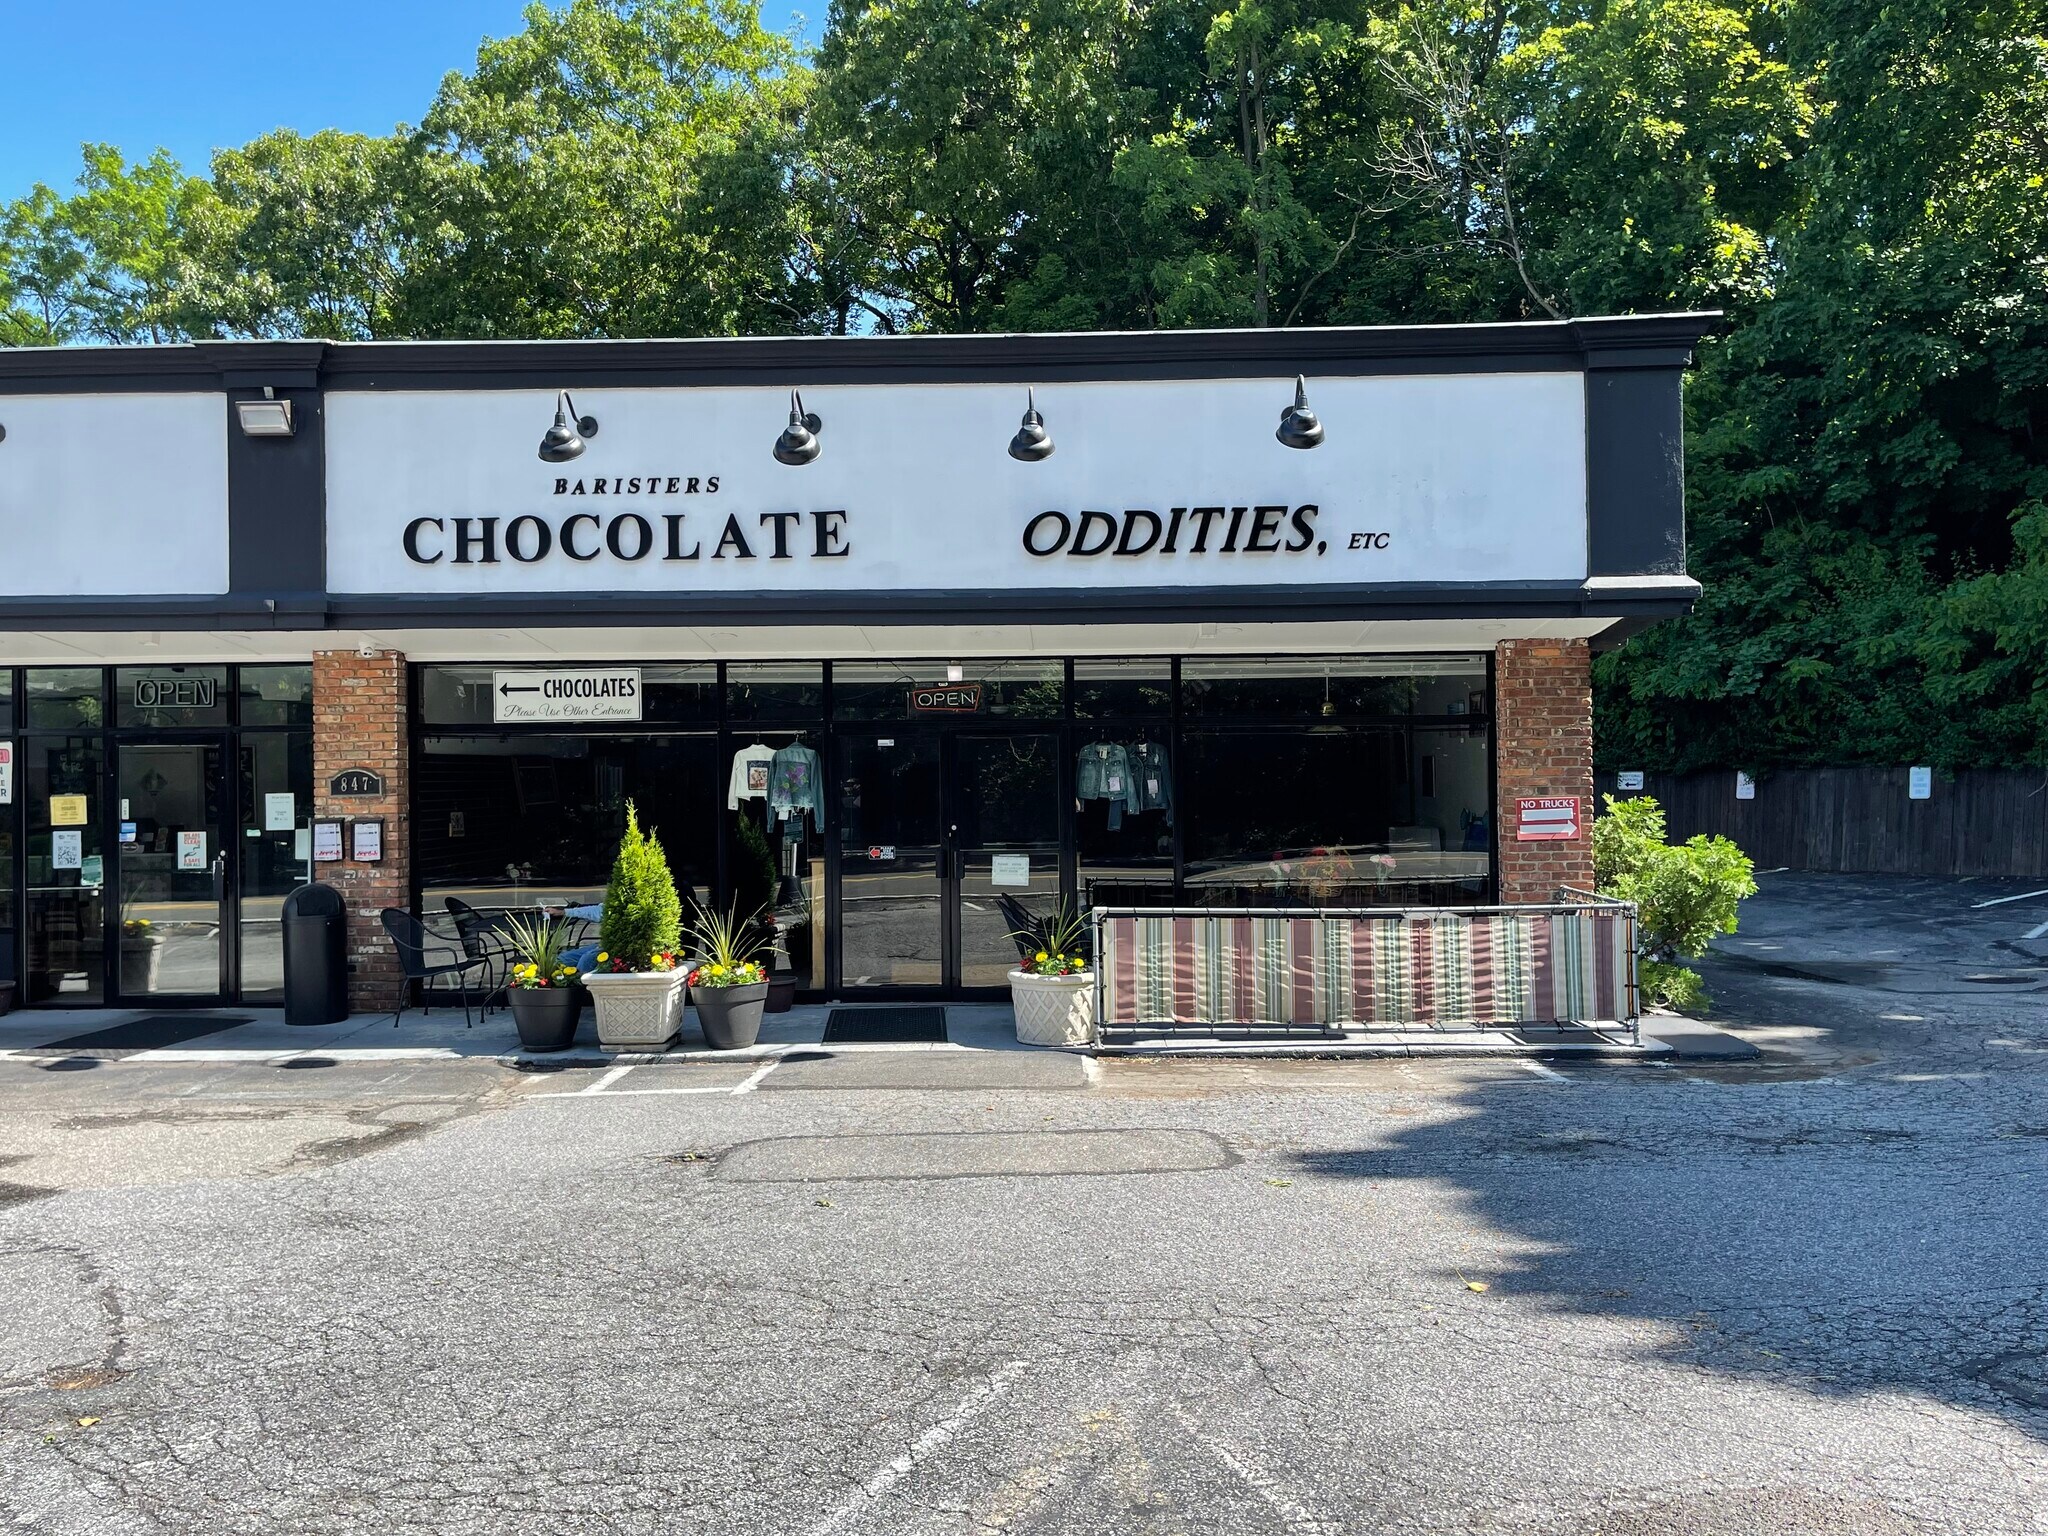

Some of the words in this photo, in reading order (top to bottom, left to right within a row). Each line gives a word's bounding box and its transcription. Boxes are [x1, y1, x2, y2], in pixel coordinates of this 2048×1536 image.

[553, 476, 721, 495] BARISTERS
[402, 509, 850, 565] CHOCOLATE
[1022, 503, 1328, 557] ODDITIES,
[1347, 532, 1390, 549] ETC
[138, 681, 211, 705] OPEN
[543, 677, 636, 698] CHOCOLATES
[918, 691, 975, 706] OPEN
[503, 704, 537, 718] Please
[538, 702, 561, 717] Use
[563, 703, 589, 716] Other
[591, 702, 632, 716] Entrance
[341, 776, 369, 792] 847
[1520, 801, 1537, 809] NO
[1540, 799, 1575, 808] TRUCKS
